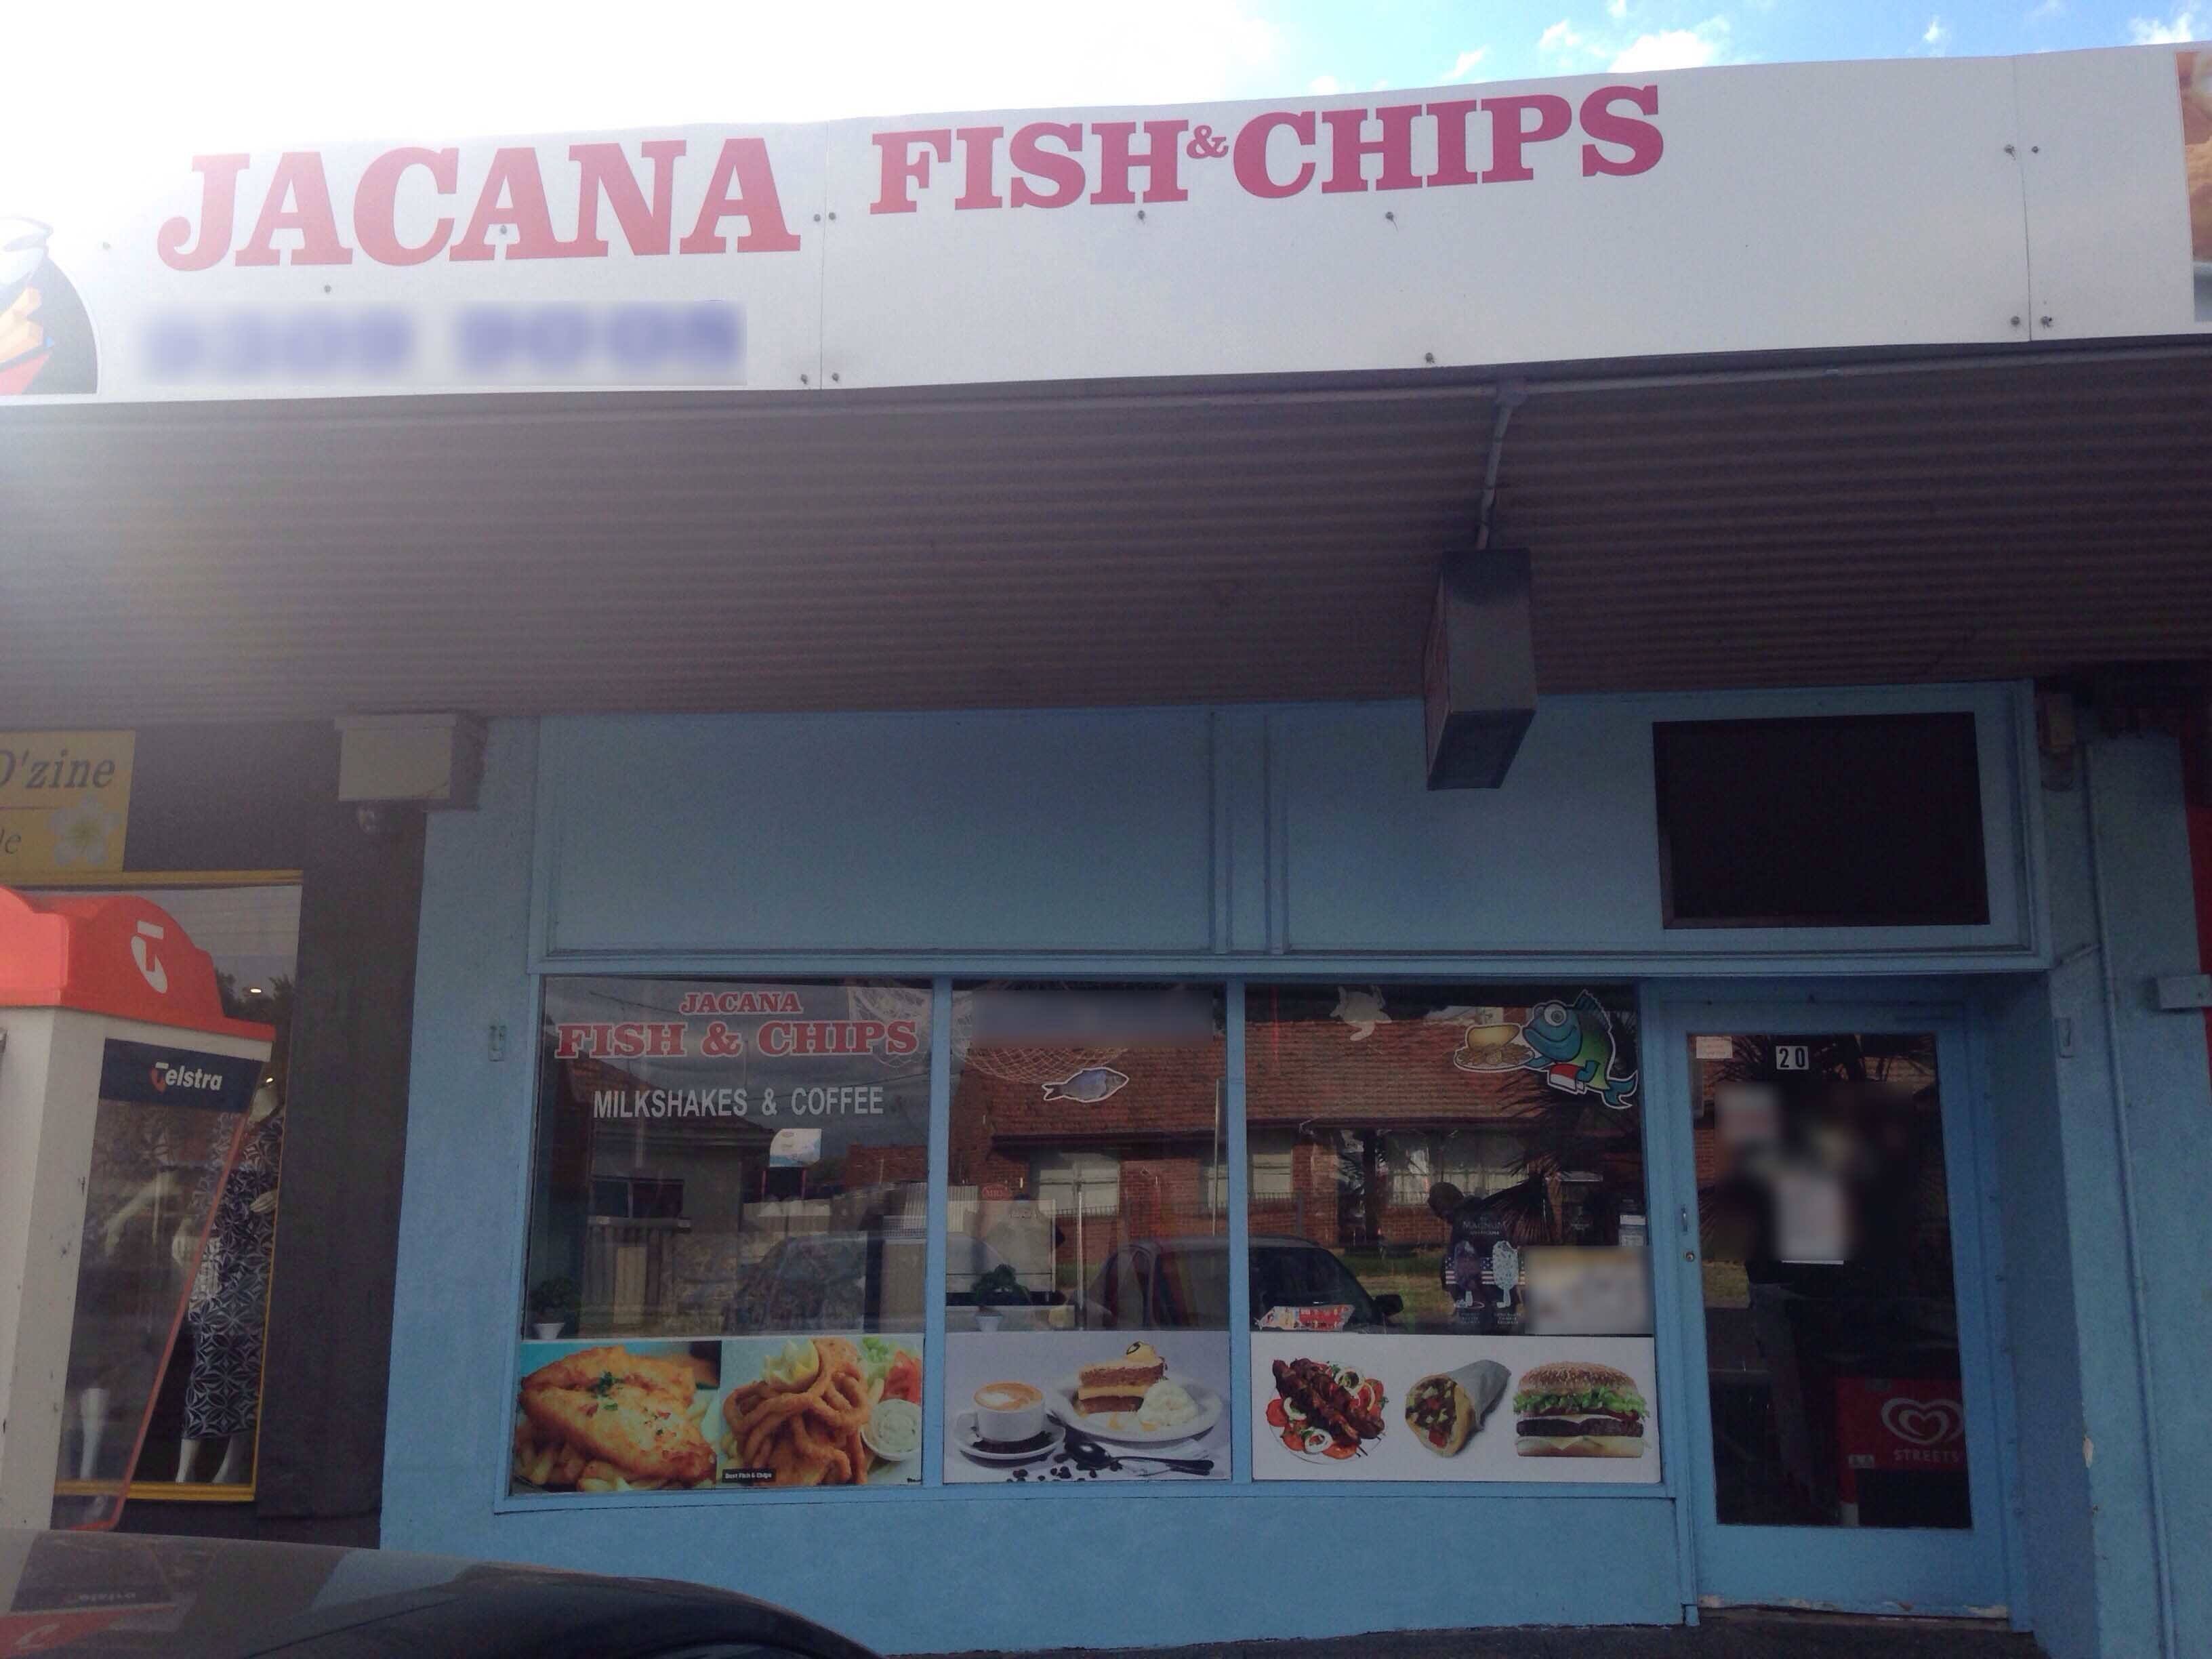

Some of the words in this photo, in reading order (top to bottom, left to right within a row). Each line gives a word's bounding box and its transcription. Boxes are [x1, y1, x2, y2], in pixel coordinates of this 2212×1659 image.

[156, 137, 801, 271] JACANA
[869, 119, 1190, 216] FISH
[1186, 124, 1229, 159] &
[1233, 84, 1664, 199] CHIPS
[679, 991, 804, 1015] JACANA
[554, 1022, 687, 1059] FISH
[700, 1021, 743, 1058] &
[757, 1019, 920, 1058] CHIPS
[1778, 1047, 1806, 1069] 20
[150, 1061, 223, 1092] Telstra
[592, 1088, 748, 1118] MILKSHAKES
[762, 1088, 778, 1117] &
[791, 1086, 884, 1116] COFFEE
